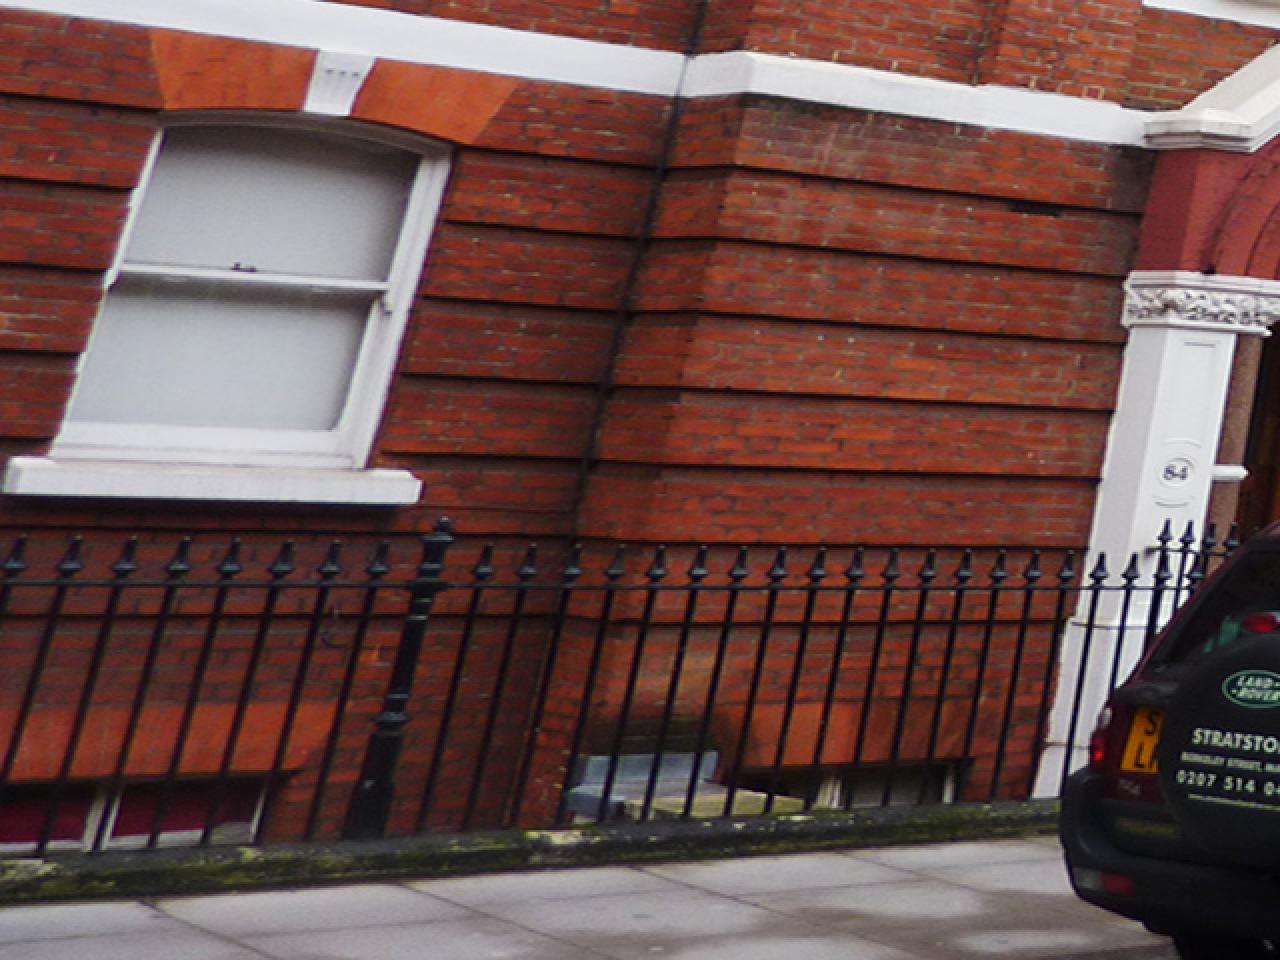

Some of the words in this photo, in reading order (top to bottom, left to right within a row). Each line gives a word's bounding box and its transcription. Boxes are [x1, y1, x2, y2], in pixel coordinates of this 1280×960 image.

[1163, 464, 1188, 481] 84
[1236, 675, 1274, 688] LAND
[1176, 769, 1217, 789] 0207
[1223, 775, 1257, 793] 514
